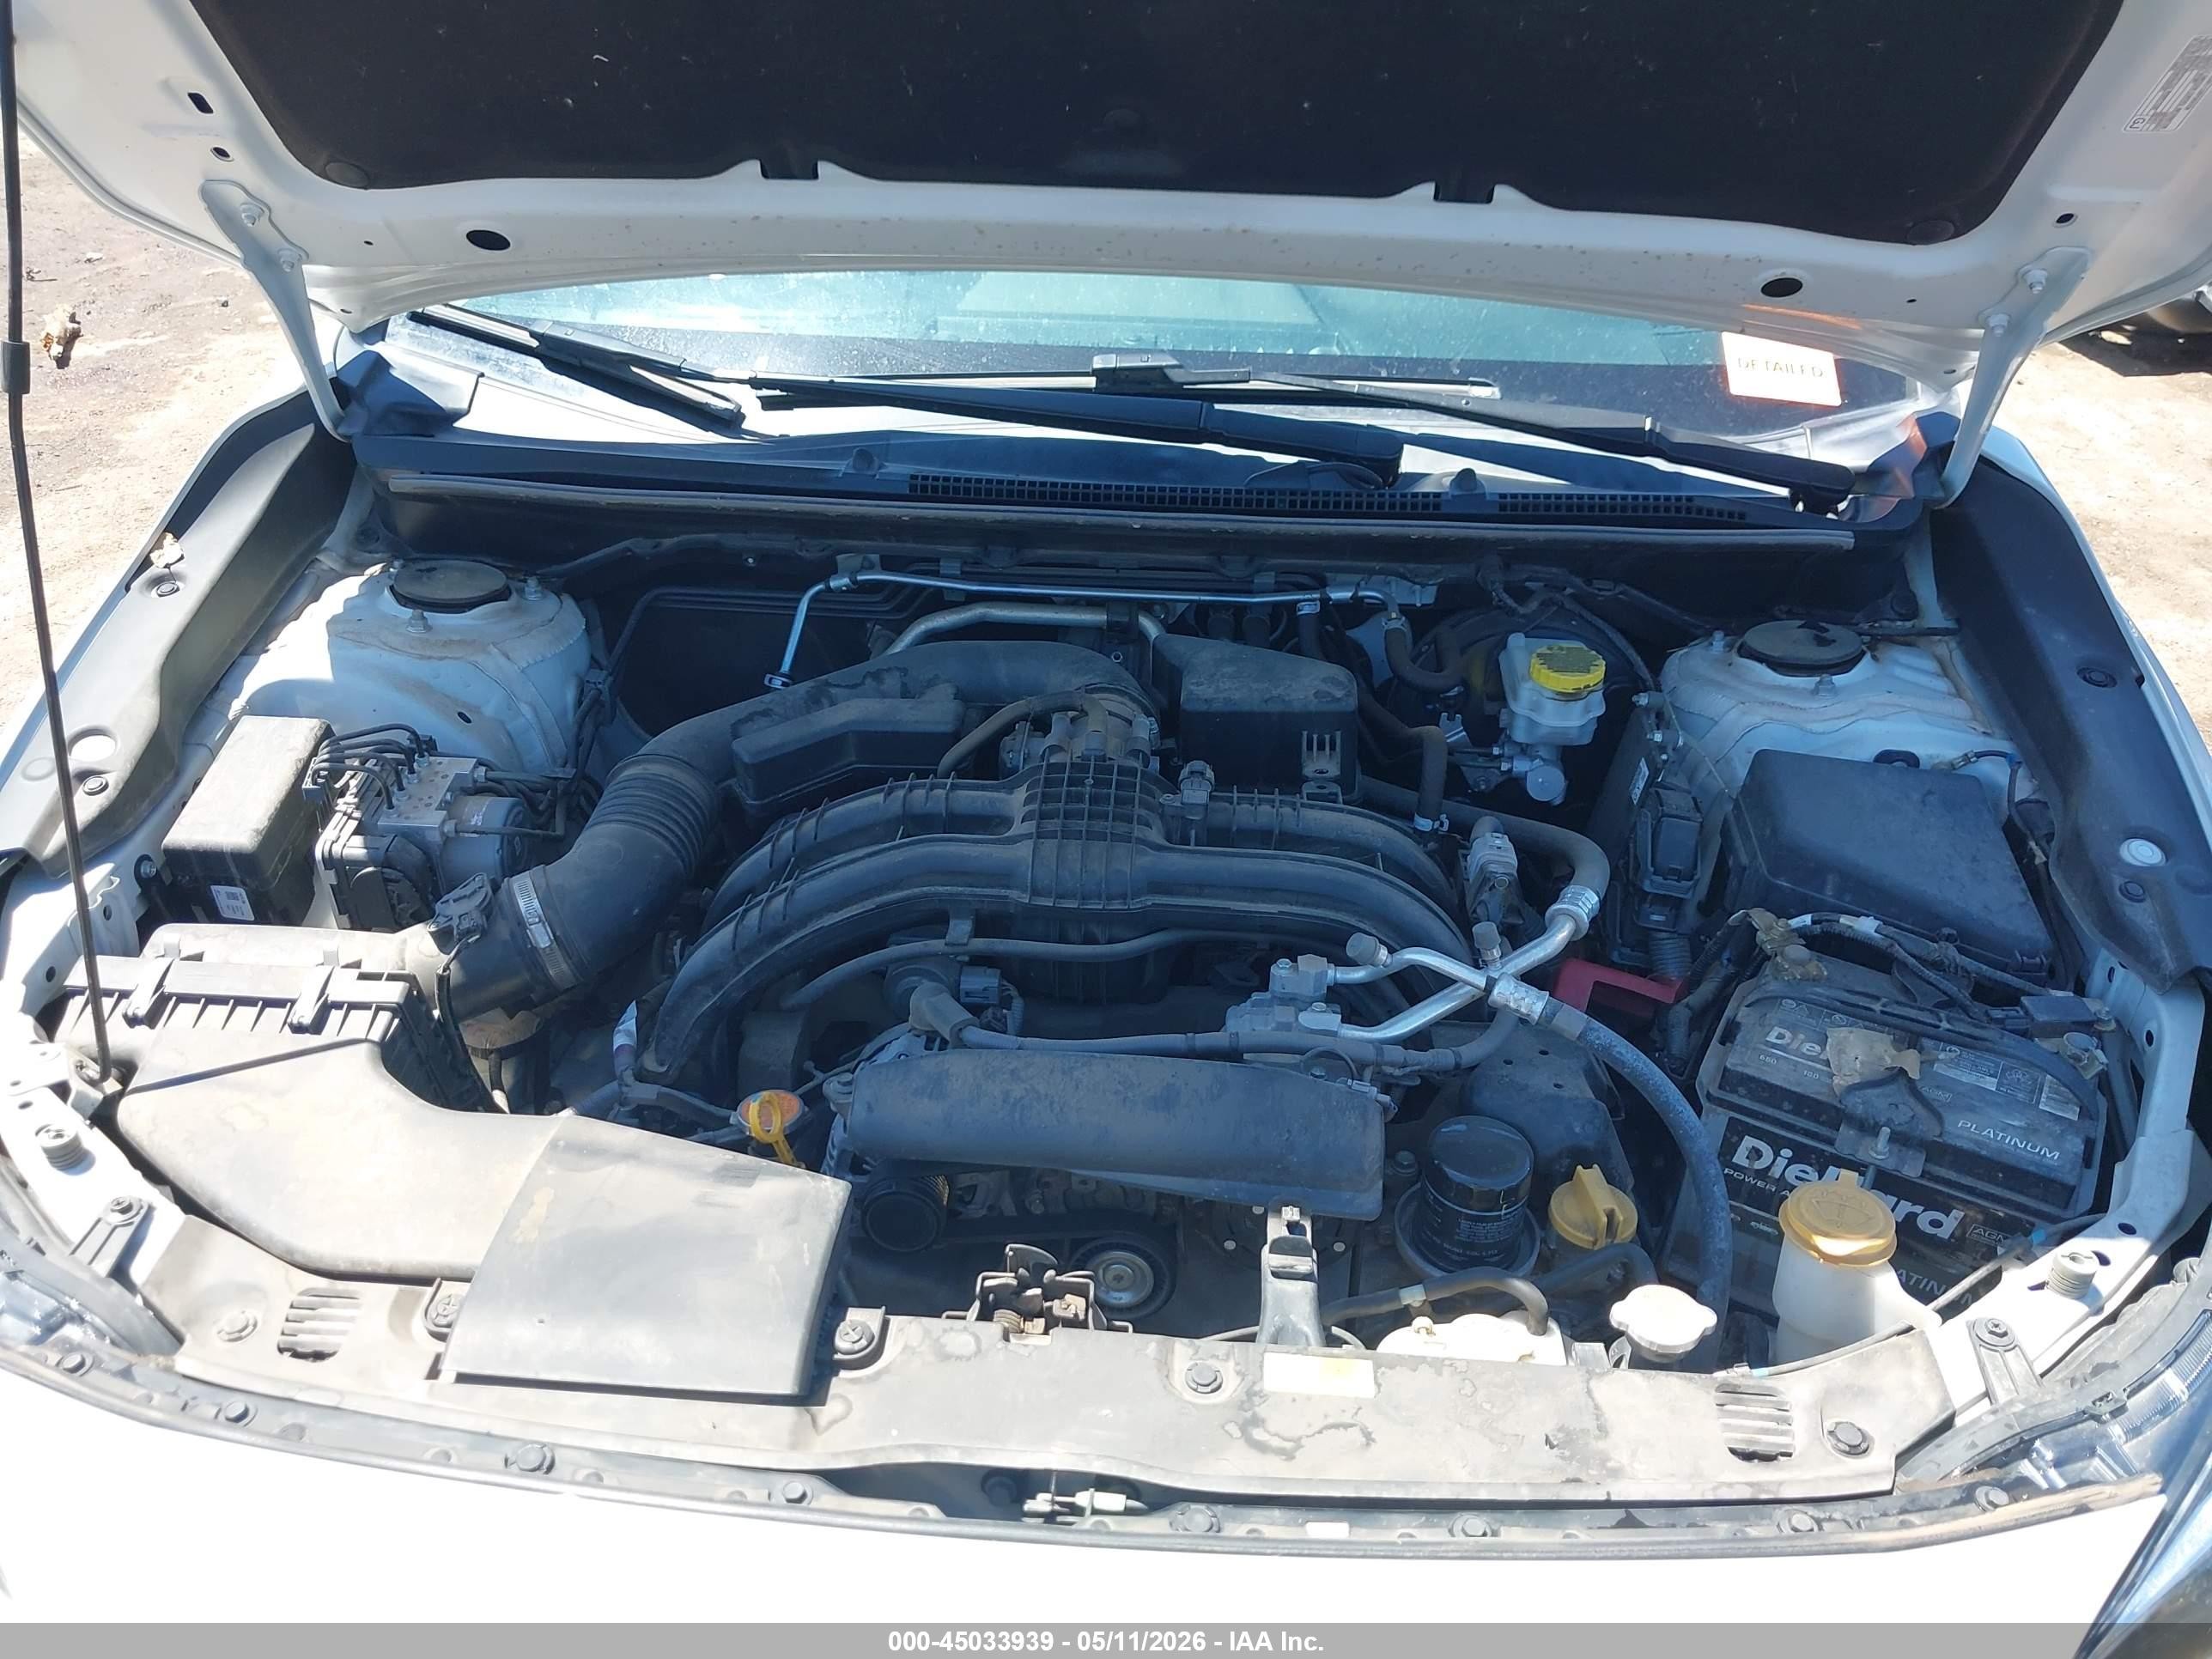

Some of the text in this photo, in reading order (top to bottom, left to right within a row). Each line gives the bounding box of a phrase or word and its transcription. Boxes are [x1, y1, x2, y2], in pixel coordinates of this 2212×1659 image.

[1958, 1120, 2060, 1160] PLATINUM
[1723, 1168, 1778, 1192] POWER
[1731, 1134, 1965, 1240] Dierd
